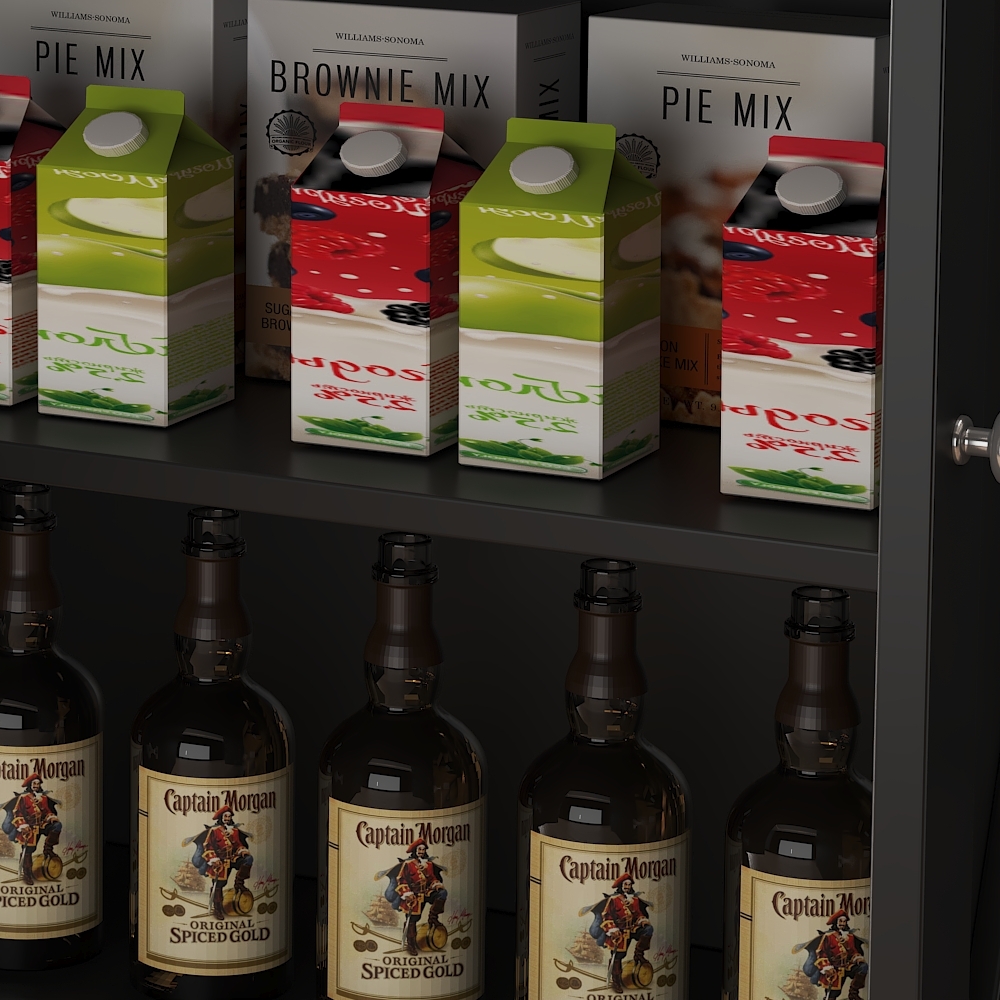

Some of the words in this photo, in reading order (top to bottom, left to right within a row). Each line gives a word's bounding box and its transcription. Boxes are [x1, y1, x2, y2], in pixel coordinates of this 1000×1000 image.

[36, 40, 78, 75] PIE
[96, 46, 145, 82] MIX
[271, 59, 414, 103] BROWNIE
[434, 72, 490, 109] MIX
[662, 86, 712, 124] PIE
[734, 92, 792, 131] MIX
[265, 302, 291, 315] SUG
[675, 358, 698, 372] MIX
[30, 757, 85, 782] Morgan
[164, 788, 222, 816] Captain
[220, 789, 276, 815] Morgan
[356, 821, 415, 848] Captain
[414, 822, 470, 848] Morgan
[560, 855, 621, 884] Captain
[620, 856, 676, 884] Morgan
[0, 885, 64, 895] ORIGINAL
[39, 892, 80, 907] GOLD
[772, 891, 834, 921] Captain
[190, 920, 254, 930] ORIGINAL
[170, 928, 227, 944] SPICED
[230, 928, 270, 943] GOLD
[382, 955, 449, 966] ORIGINAL
[361, 963, 420, 980] SPICED
[424, 963, 464, 979] GOLD
